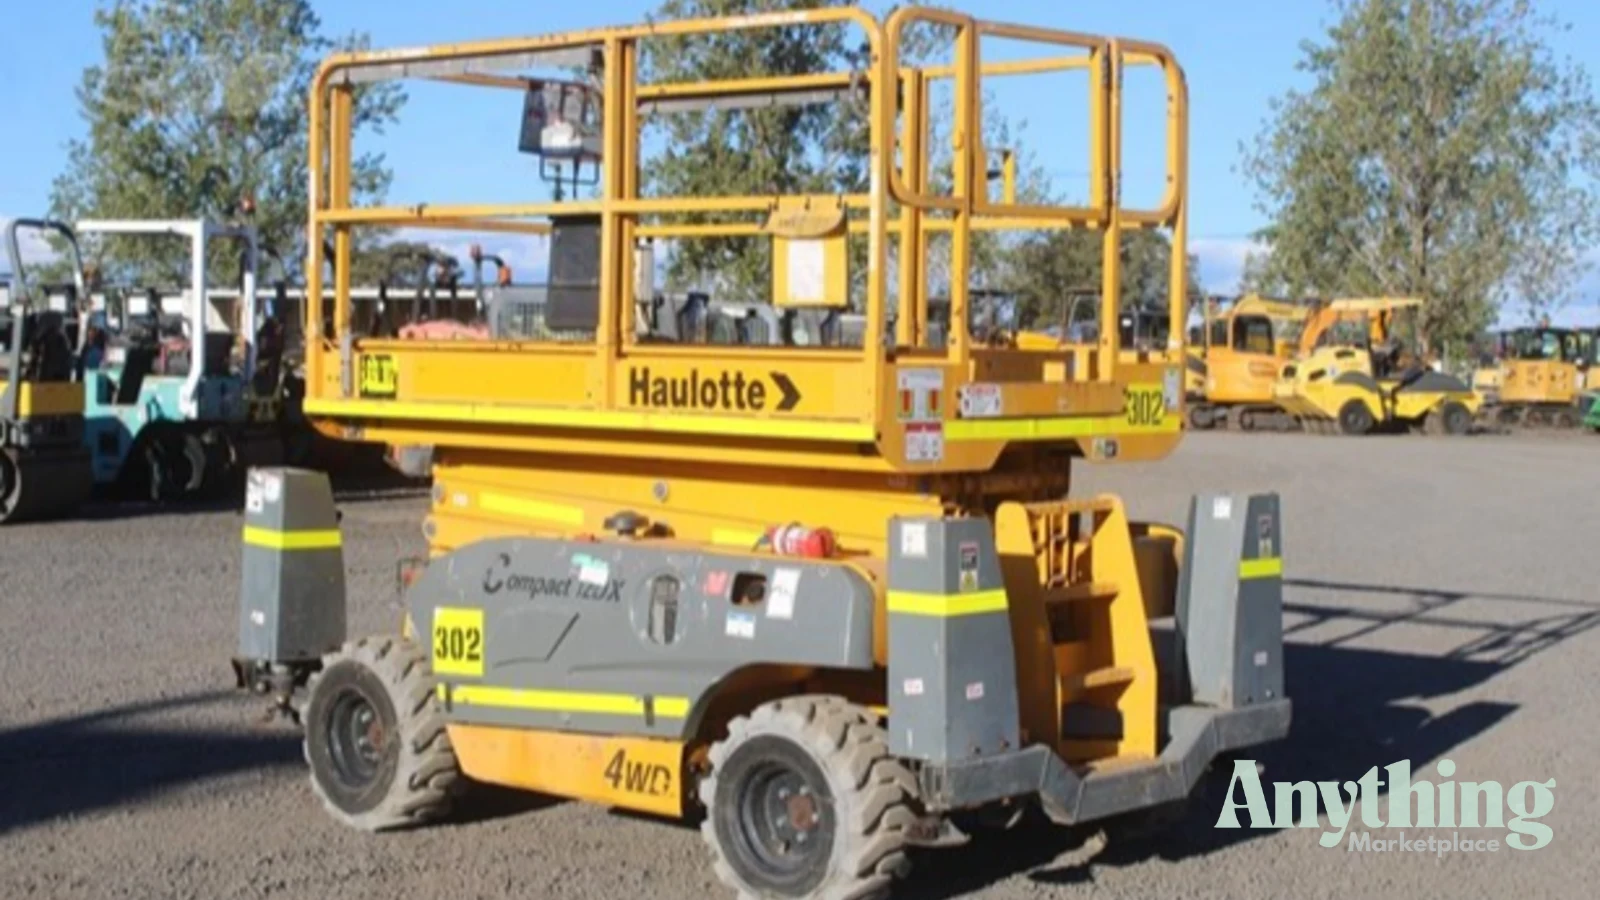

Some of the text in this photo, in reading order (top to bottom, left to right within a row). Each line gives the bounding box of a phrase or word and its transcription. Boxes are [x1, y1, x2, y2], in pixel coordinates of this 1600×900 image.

[629, 366, 766, 410] Haulotte
[1126, 391, 1163, 425] 302
[483, 553, 571, 599] Compact
[435, 626, 480, 661] 302
[604, 748, 671, 796] 4WD
